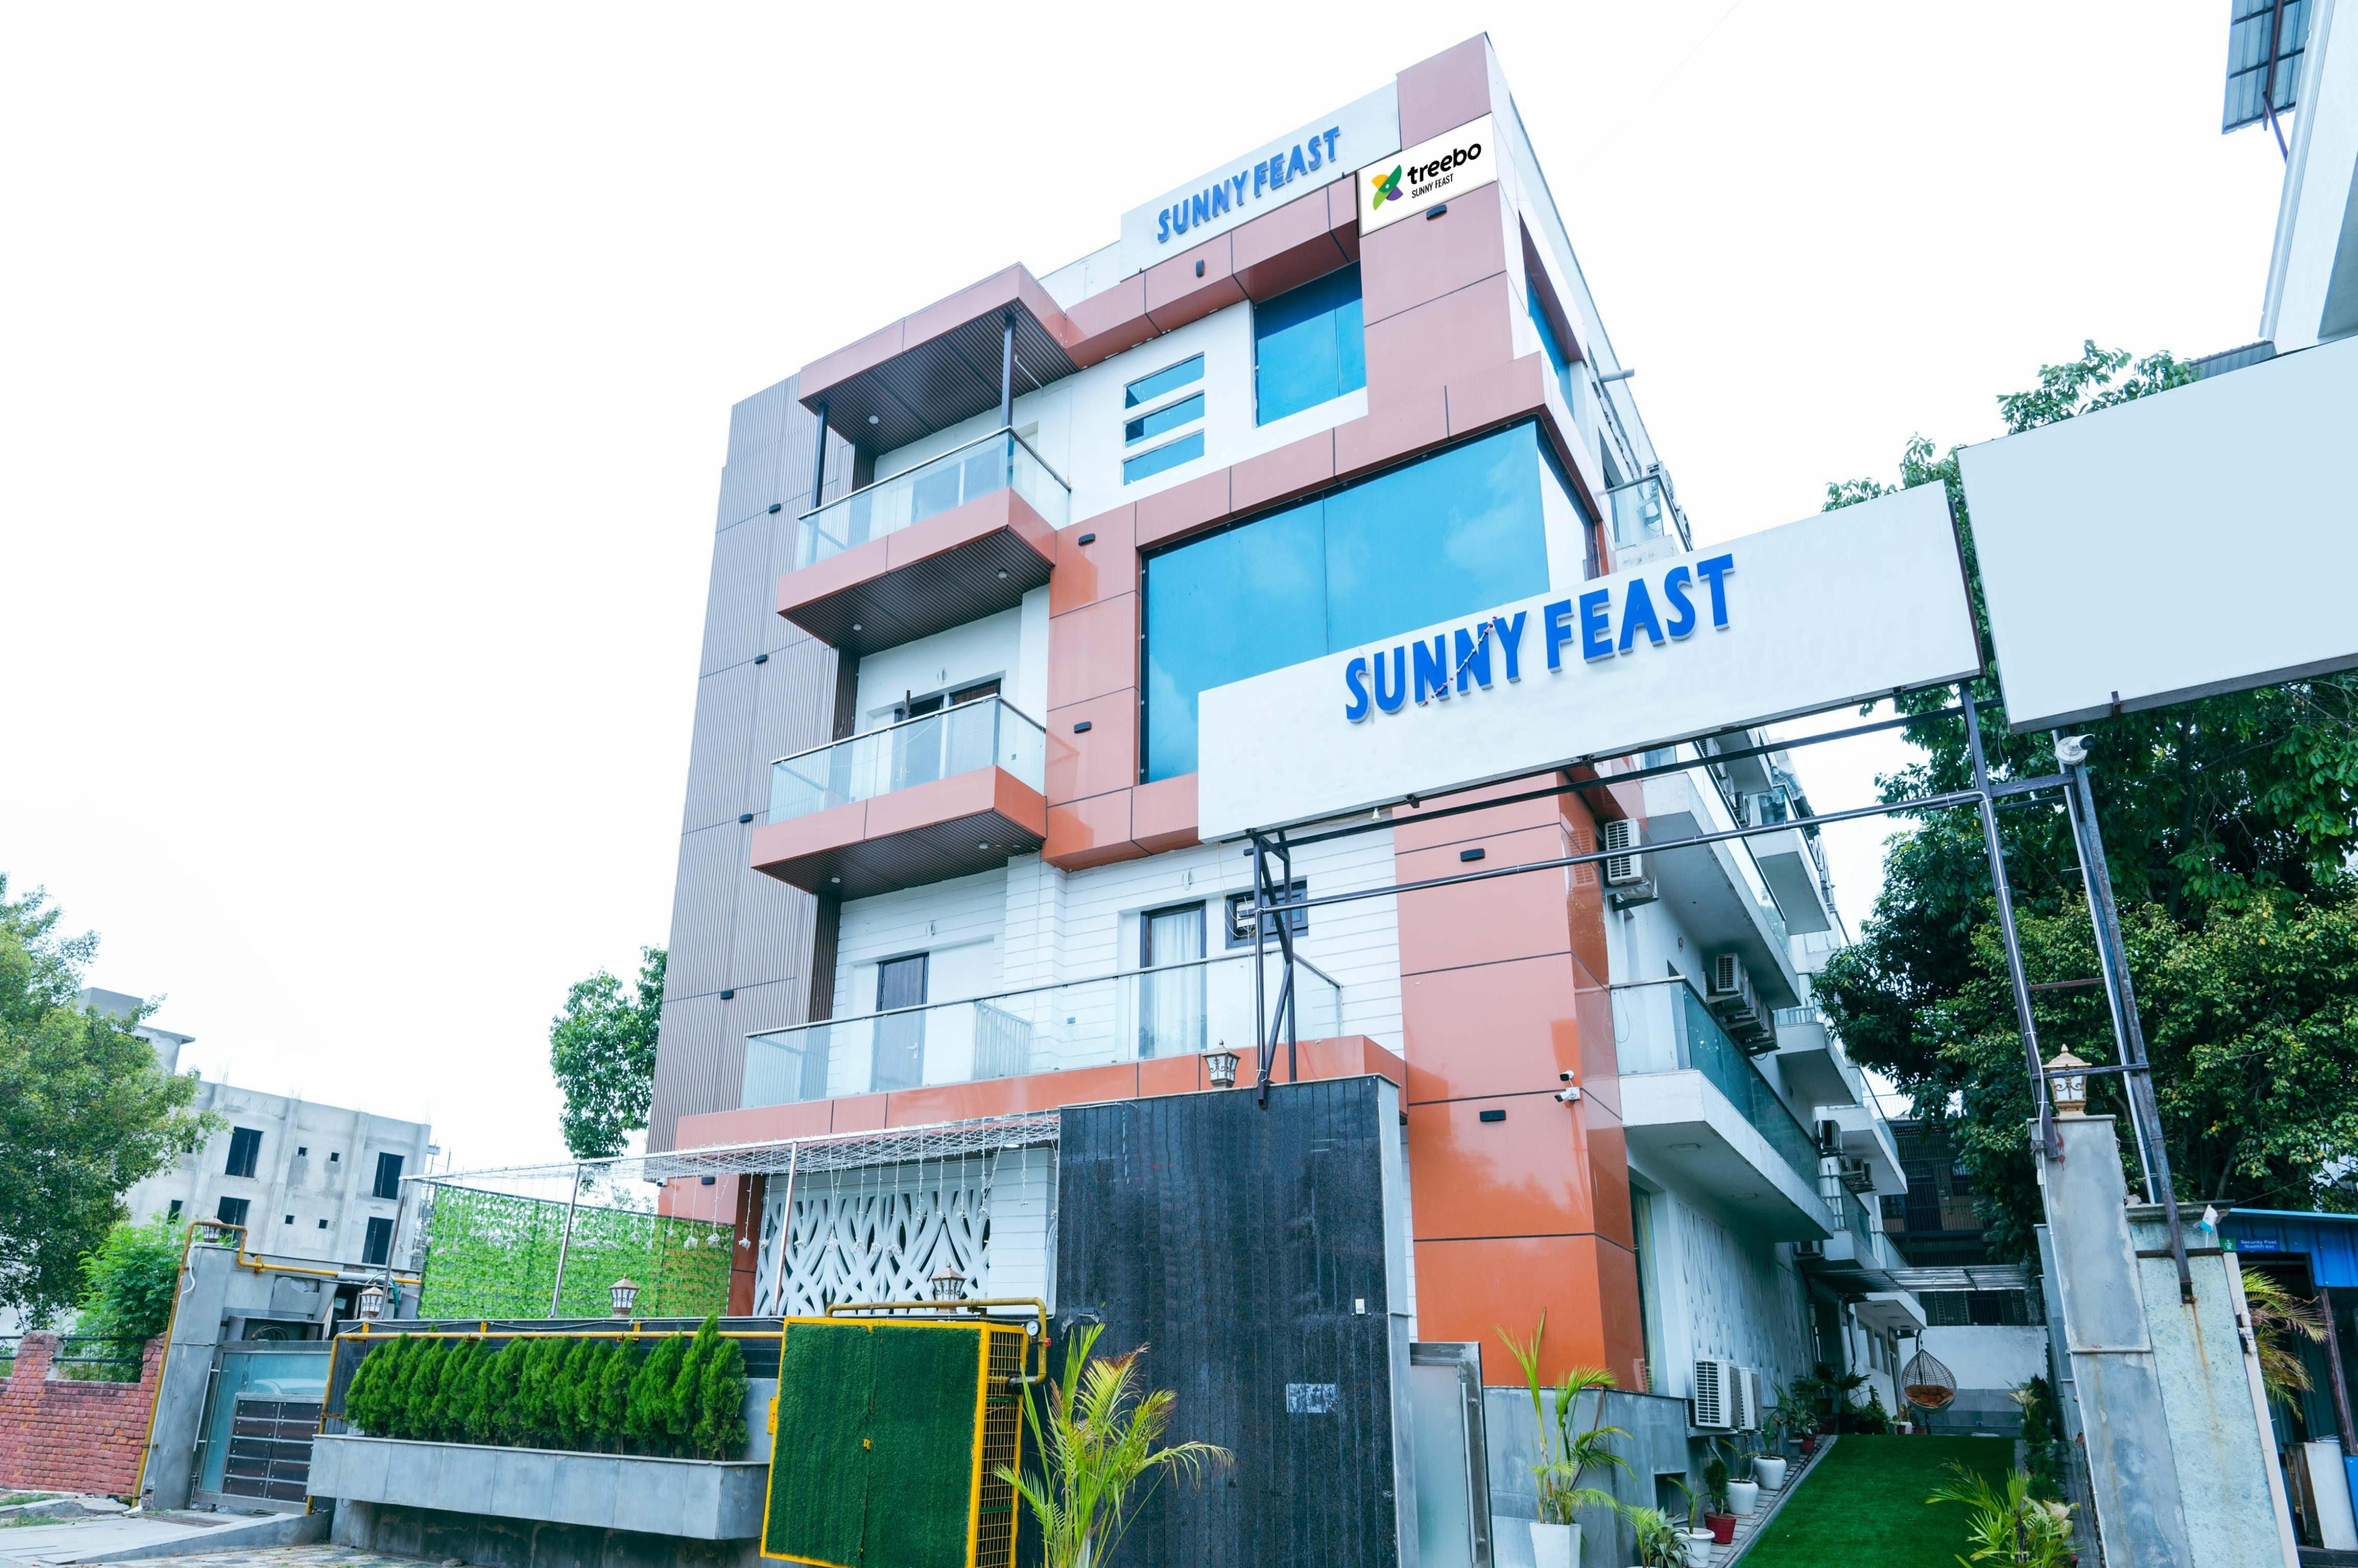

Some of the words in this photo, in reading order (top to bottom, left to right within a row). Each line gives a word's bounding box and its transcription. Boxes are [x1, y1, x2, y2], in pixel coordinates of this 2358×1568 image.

[1157, 169, 1249, 244] SUNNY
[1254, 125, 1341, 199] FEAST
[1407, 143, 1482, 184] treebo
[1412, 181, 1433, 199] SUNNY
[1435, 173, 1454, 189] FEAST
[1345, 610, 1529, 723] SUNNY
[1544, 553, 1735, 674] FEAST
